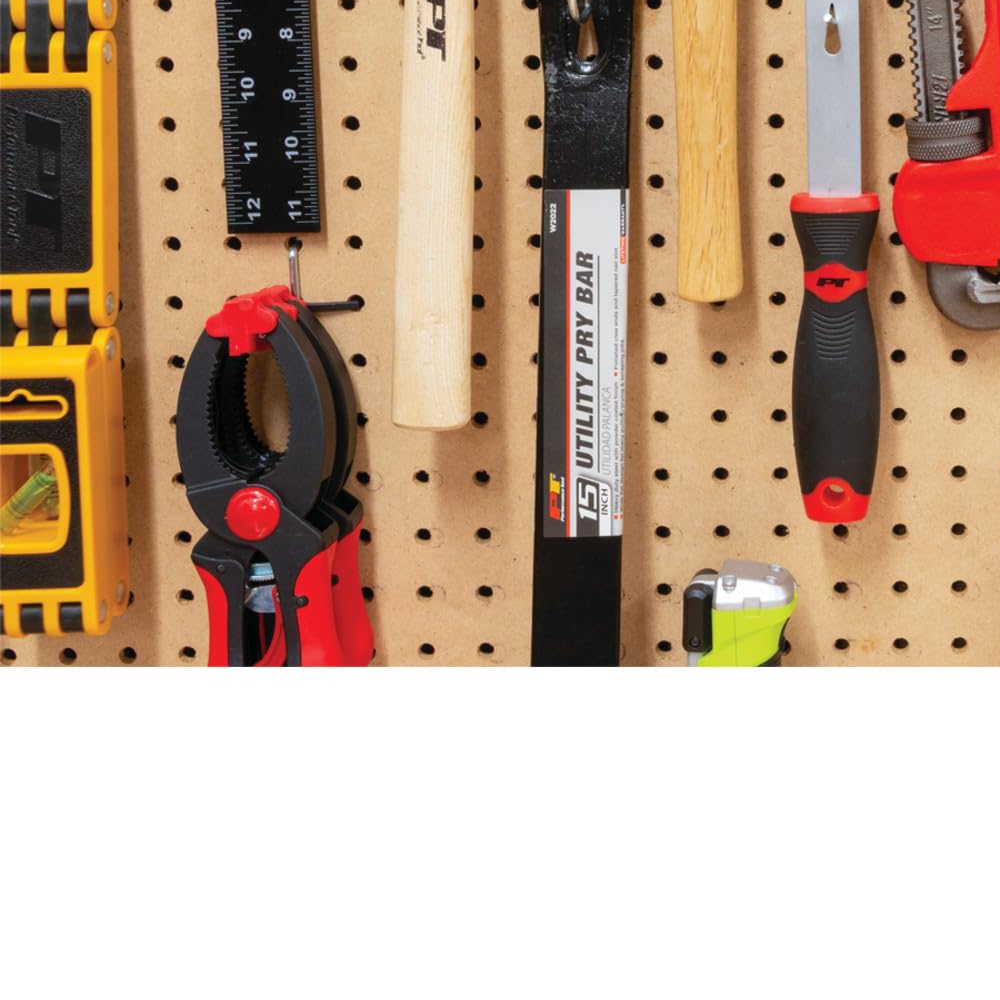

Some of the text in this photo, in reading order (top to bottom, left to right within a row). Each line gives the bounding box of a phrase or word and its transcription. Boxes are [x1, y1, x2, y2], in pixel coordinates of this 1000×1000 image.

[239, 29, 251, 40] 9
[280, 28, 293, 39] 8
[241, 78, 254, 100] 10
[283, 89, 296, 100] 9
[244, 142, 257, 161] 11
[285, 137, 298, 159] 10
[247, 198, 260, 220] 12
[288, 201, 301, 219] 11
[549, 202, 557, 233] W2022
[816, 277, 851, 288] PT
[575, 250, 594, 469] UTILITY PRY BAR
[601, 386, 611, 476] UTILIDAD PALANCA
[549, 472, 561, 521] PT
[578, 482, 598, 521] 15
[601, 488, 609, 516] INCH
